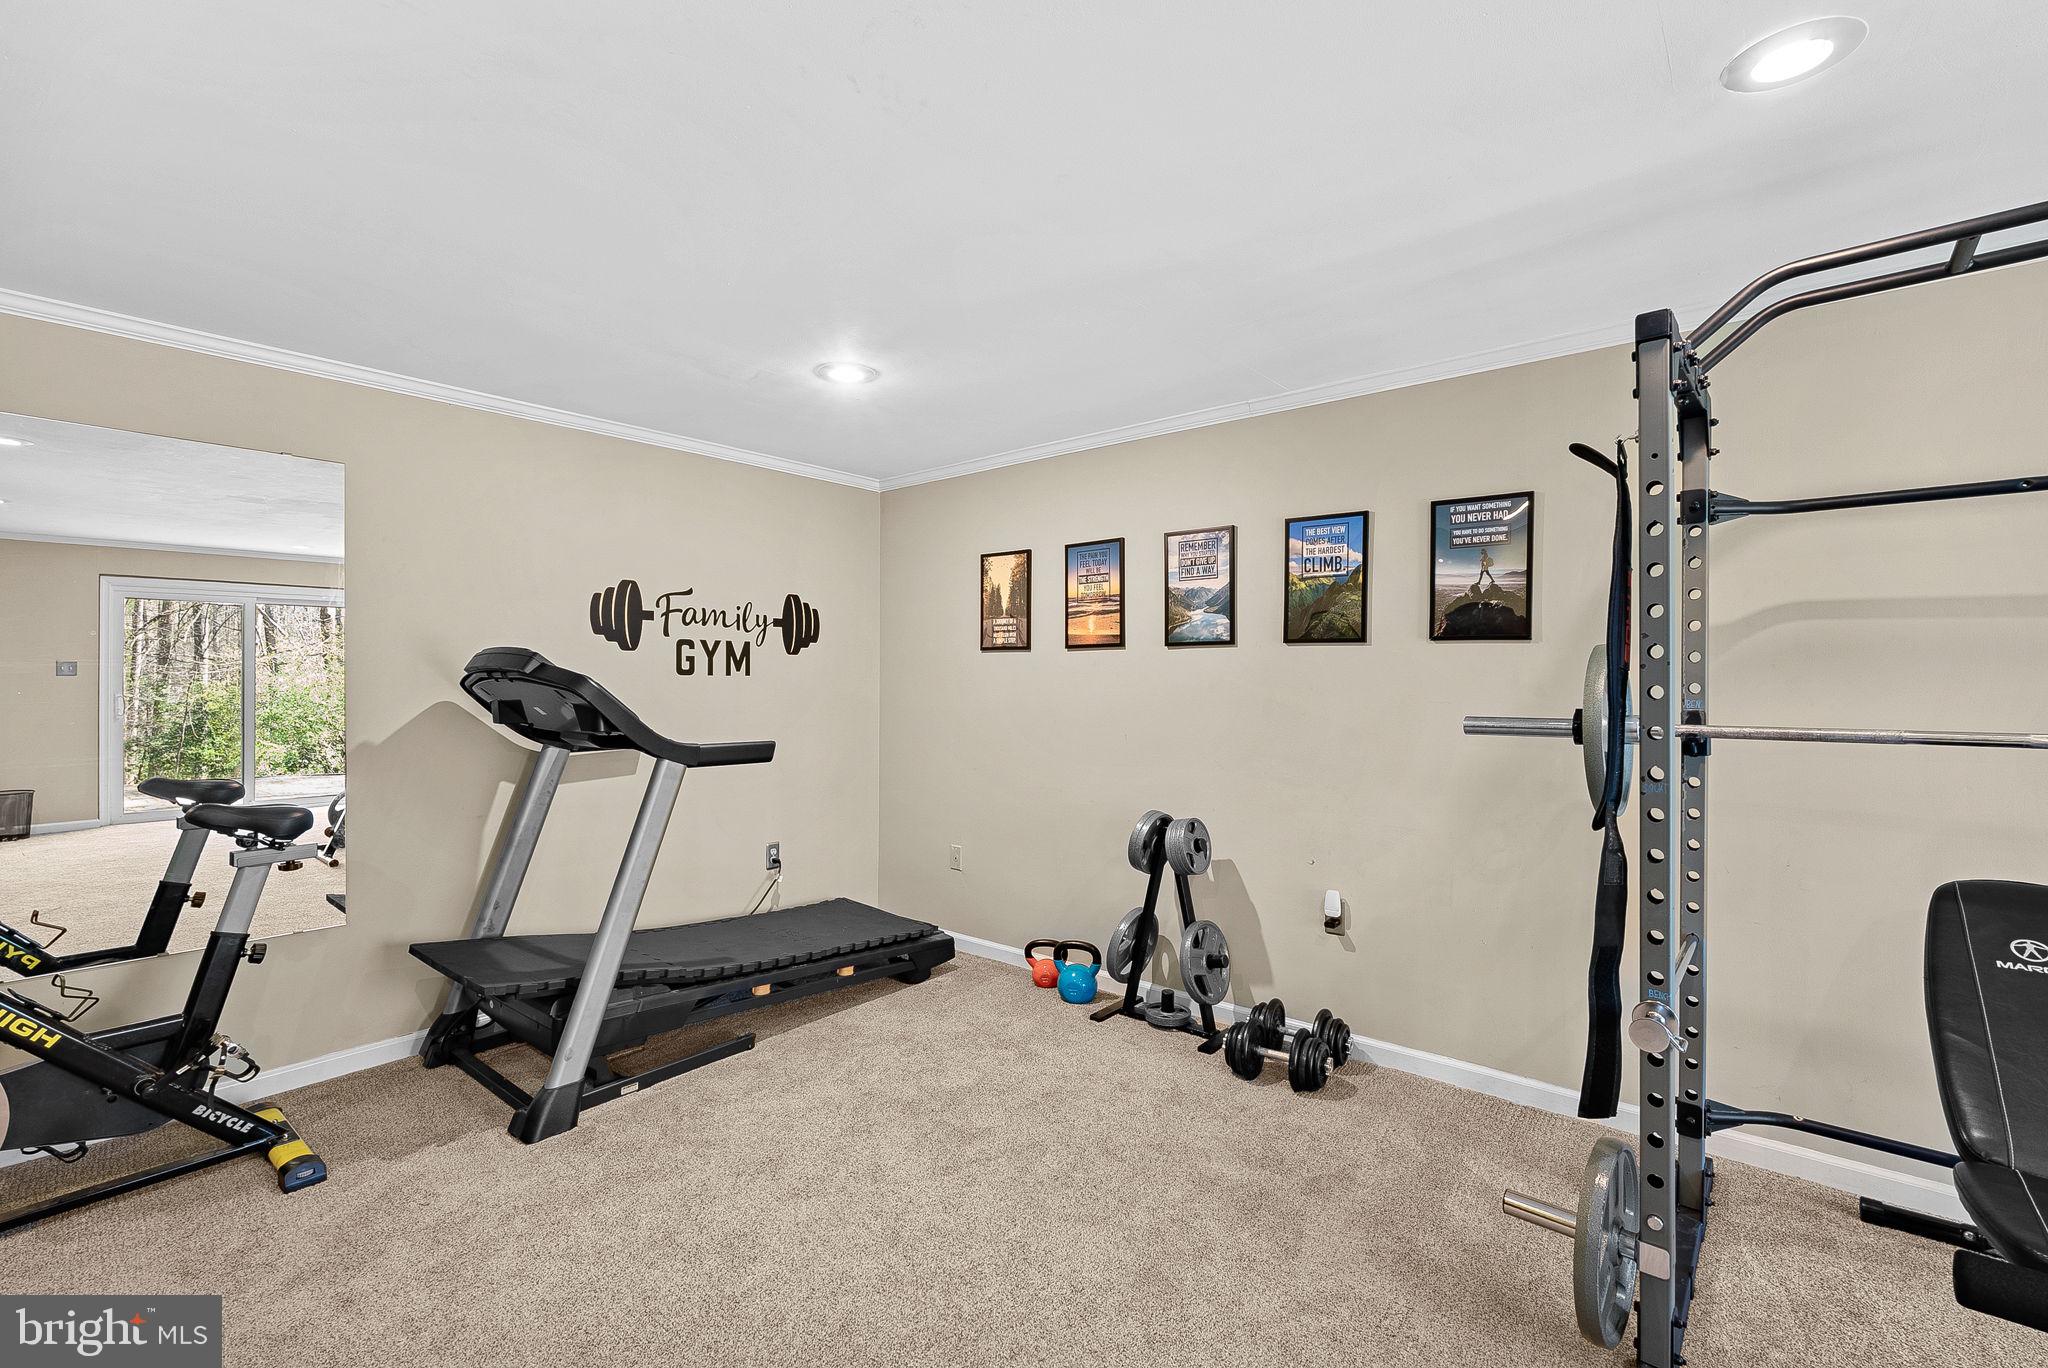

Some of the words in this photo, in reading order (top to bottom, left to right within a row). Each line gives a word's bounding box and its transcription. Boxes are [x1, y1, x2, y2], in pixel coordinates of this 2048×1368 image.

[1482, 500, 1512, 510] SOMETHING
[1451, 514, 1466, 524] YOU
[1467, 511, 1491, 522] NEVER
[1306, 528, 1316, 536] THE
[1317, 527, 1330, 535] BEST
[1332, 525, 1346, 534] VIEW
[1306, 537, 1326, 546] COMES
[1327, 535, 1345, 544] AFTER
[1453, 537, 1472, 545] YOU'VE
[1472, 535, 1490, 543] NEVER
[1180, 540, 1216, 552] REMEMBER
[1306, 548, 1316, 556] THE
[1318, 545, 1345, 554] HARDEST
[1304, 556, 1346, 572] CLIMB.
[1181, 567, 1194, 576] FIND
[1196, 567, 1200, 575] A
[655, 587, 773, 647] Family
[676, 638, 750, 676] GYM
[192, 1104, 254, 1133] BICYCLE
